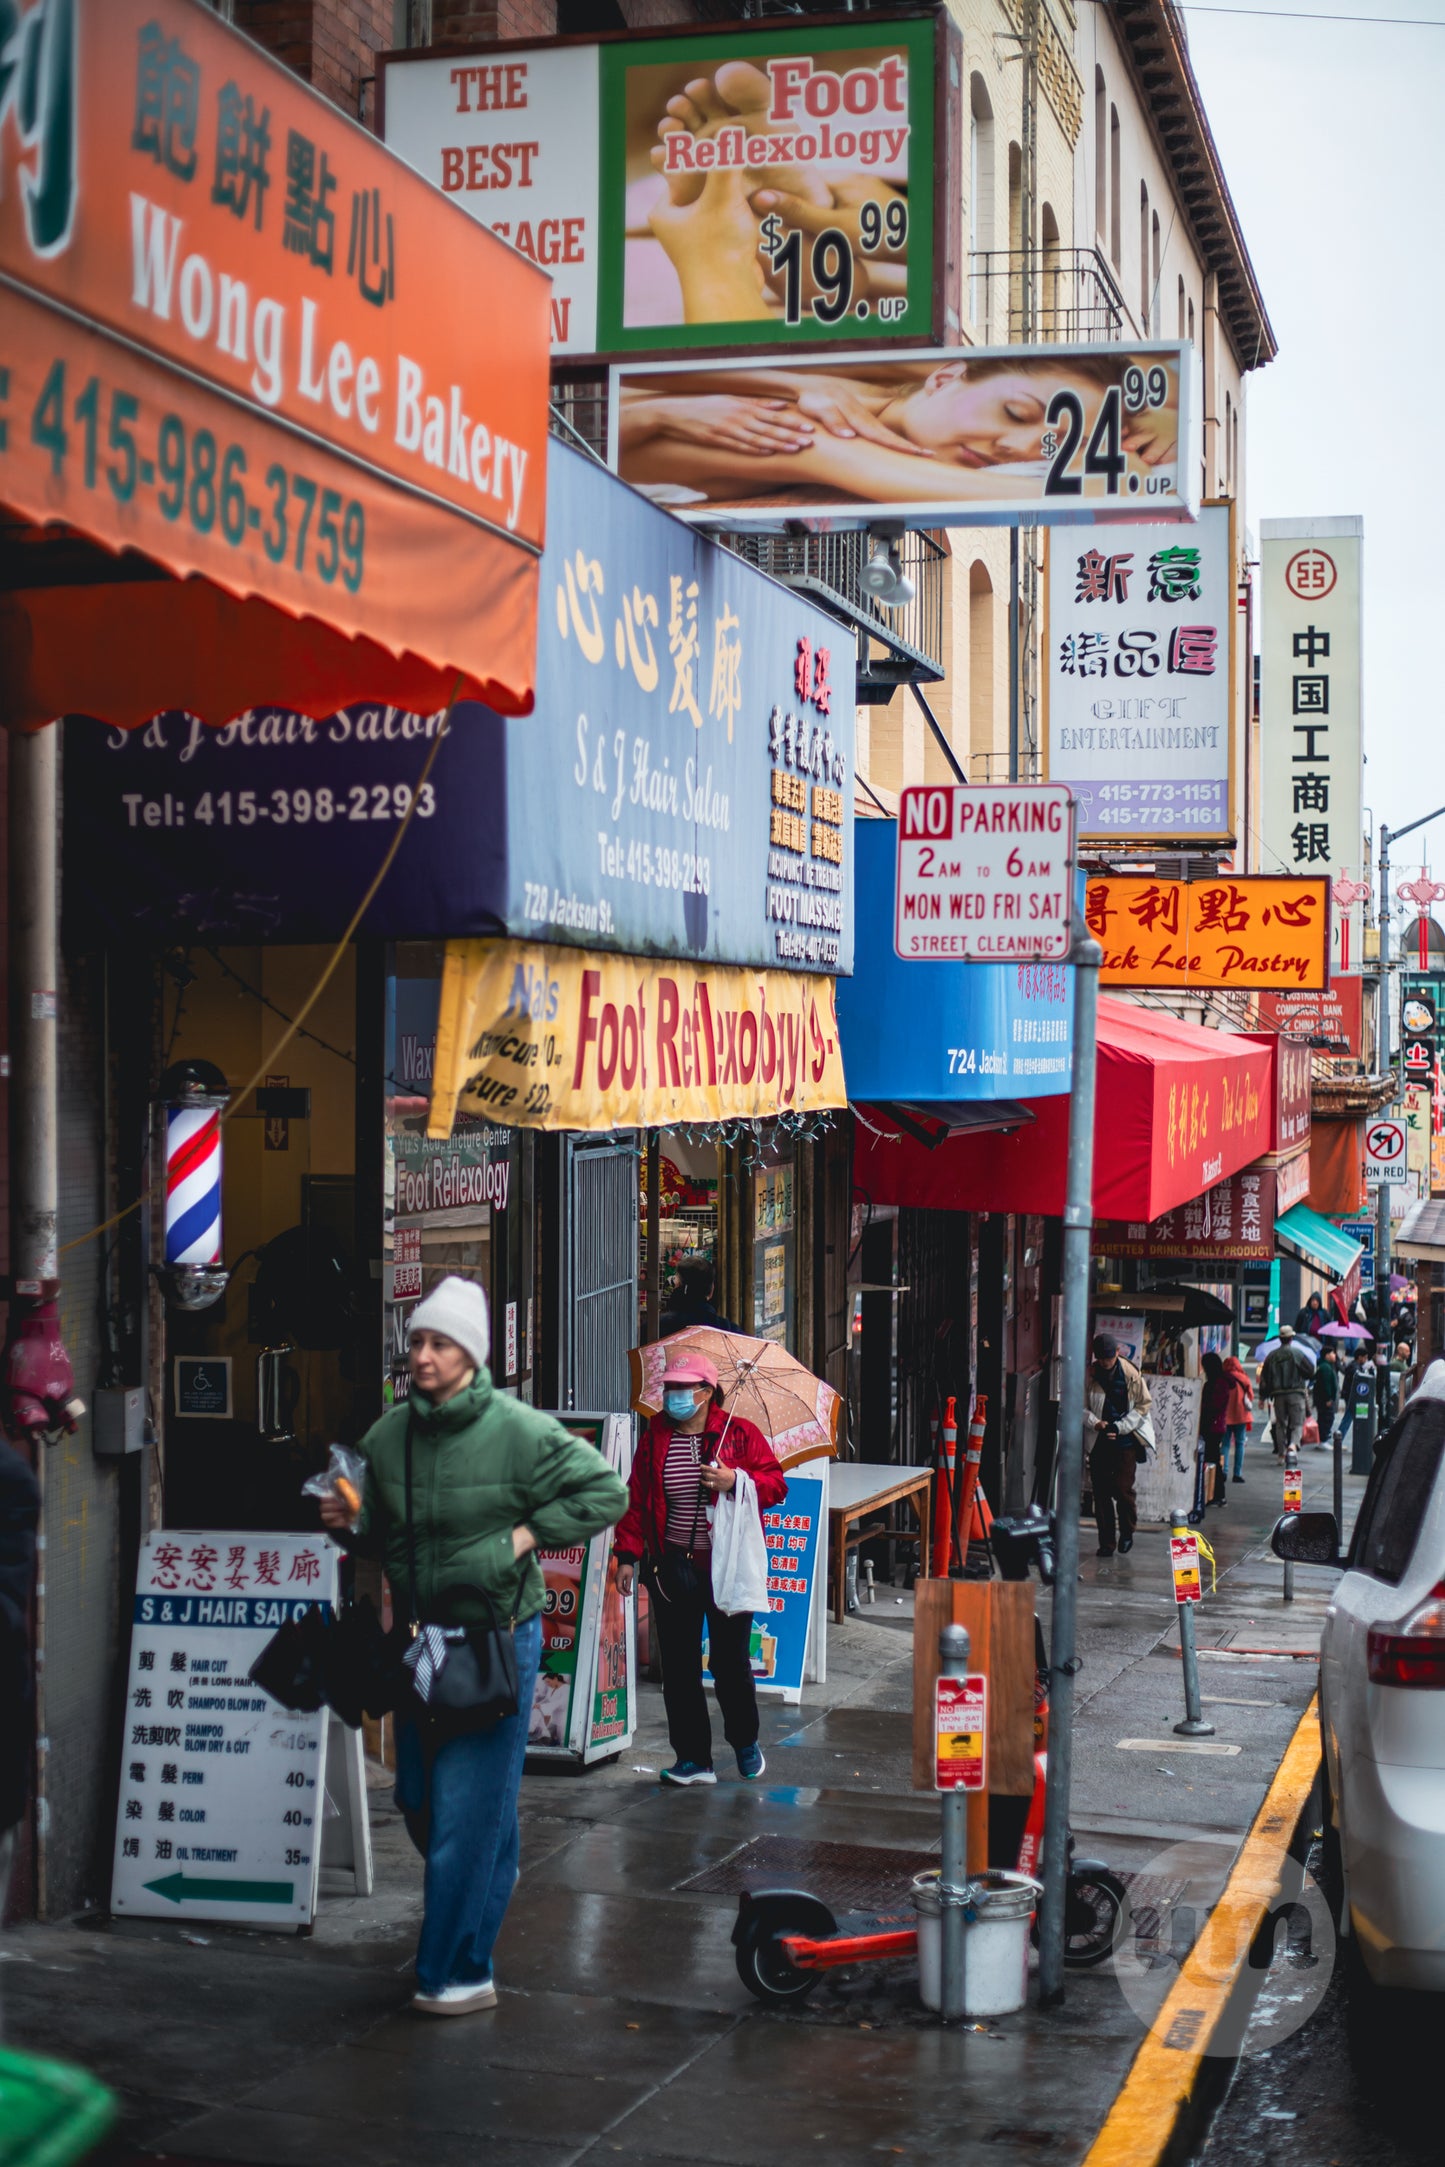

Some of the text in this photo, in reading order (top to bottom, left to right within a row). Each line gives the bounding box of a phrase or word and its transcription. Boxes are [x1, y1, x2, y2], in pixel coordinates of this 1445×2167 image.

[450, 62, 530, 114] THE
[767, 55, 907, 122] Foot
[664, 123, 912, 172] Reflexology
[440, 142, 540, 192] BEST
[878, 298, 908, 321] UP
[129, 191, 530, 531] Wong Lee Bakery
[31, 359, 367, 594] 415-986-3759
[1145, 476, 1172, 496] UP
[1059, 625, 1219, 680] 精品屋
[1090, 697, 1188, 721] GIFT
[1059, 725, 1220, 751] ENTERTAINMENT
[1290, 624, 1332, 864] 中国工商银
[573, 713, 590, 788] S
[629, 733, 679, 820] Hair
[682, 756, 731, 833] Salon
[122, 783, 436, 827] Tel: 415-398-2293
[1098, 784, 1222, 803] 415-773-1151
[904, 791, 1063, 836] NO PARKING
[1098, 807, 1222, 826] 415-773-1161
[627, 840, 711, 896] 415-398-2293
[976, 865, 991, 878] TO
[523, 881, 548, 921] 728
[548, 887, 598, 932] Jackson
[766, 884, 844, 934] FOOT MASSAGE
[903, 892, 1063, 920] MON WED FRI SAT
[910, 935, 1054, 953] STREET CLEANING
[1100, 943, 1311, 982] ick Lee Pastry
[1322, 1004, 1343, 1017] BANK
[571, 969, 648, 1092] Foot
[1293, 1019, 1314, 1031] CHINA
[947, 1049, 976, 1074] 724
[482, 1125, 512, 1148] Center
[394, 1150, 510, 1214] Foot Reflexology
[1366, 1166, 1404, 1176] ON RED
[1241, 1174, 1262, 1242] 零食天地
[1093, 1244, 1271, 1258] GARETTES DRINKS DAILY PRODUCT
[141, 1598, 155, 1622] S
[160, 1601, 174, 1623] &
[179, 1600, 192, 1623] J
[197, 1600, 249, 1626] HAIR
[551, 1637, 572, 1650] UP
[190, 1659, 210, 1673] HAIR
[211, 1660, 228, 1673] CUT
[187, 1696, 226, 1710] SHAMPOO
[227, 1697, 250, 1711] BLOW
[250, 1699, 267, 1712] DRY
[601, 1693, 618, 1718] Foot
[940, 1705, 954, 1713] NO
[184, 1723, 224, 1738] SHAMPOO
[184, 1739, 207, 1752] BLOW
[208, 1740, 224, 1753] DRY
[234, 1741, 250, 1754] CUT
[182, 1771, 204, 1785] PERM
[286, 1772, 305, 1787] 40
[179, 1810, 206, 1823] COLOR
[283, 1811, 302, 1826] 40
[176, 1847, 191, 1860] OIL
[192, 1848, 238, 1862] TREATMENT
[284, 1849, 302, 1866] 35
